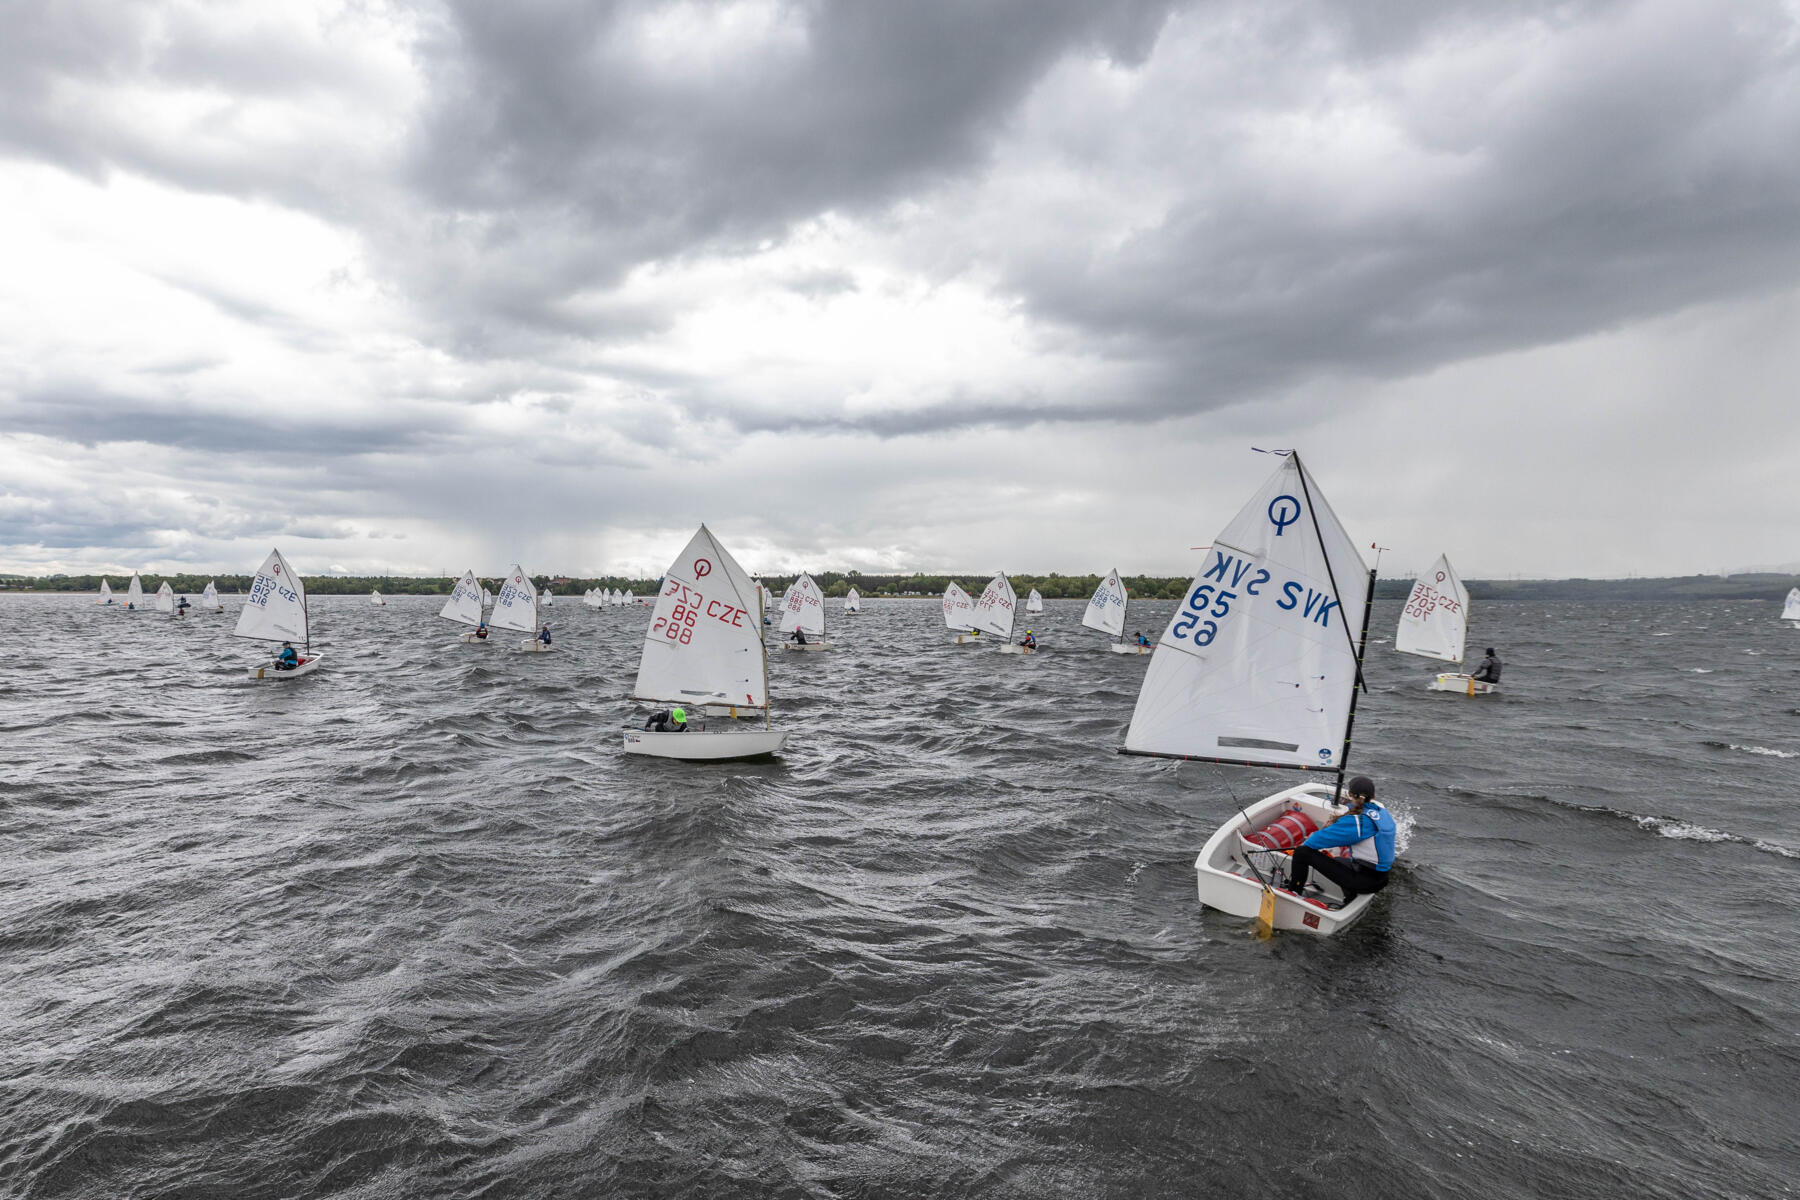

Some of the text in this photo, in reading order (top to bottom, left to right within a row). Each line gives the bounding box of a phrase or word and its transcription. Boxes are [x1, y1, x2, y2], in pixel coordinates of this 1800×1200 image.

[279, 586, 297, 602] CZE
[1189, 585, 1237, 618] 65
[1275, 581, 1340, 628] SVK
[1410, 594, 1436, 611] 703
[1439, 596, 1461, 614] CZE
[707, 600, 748, 628] CZE
